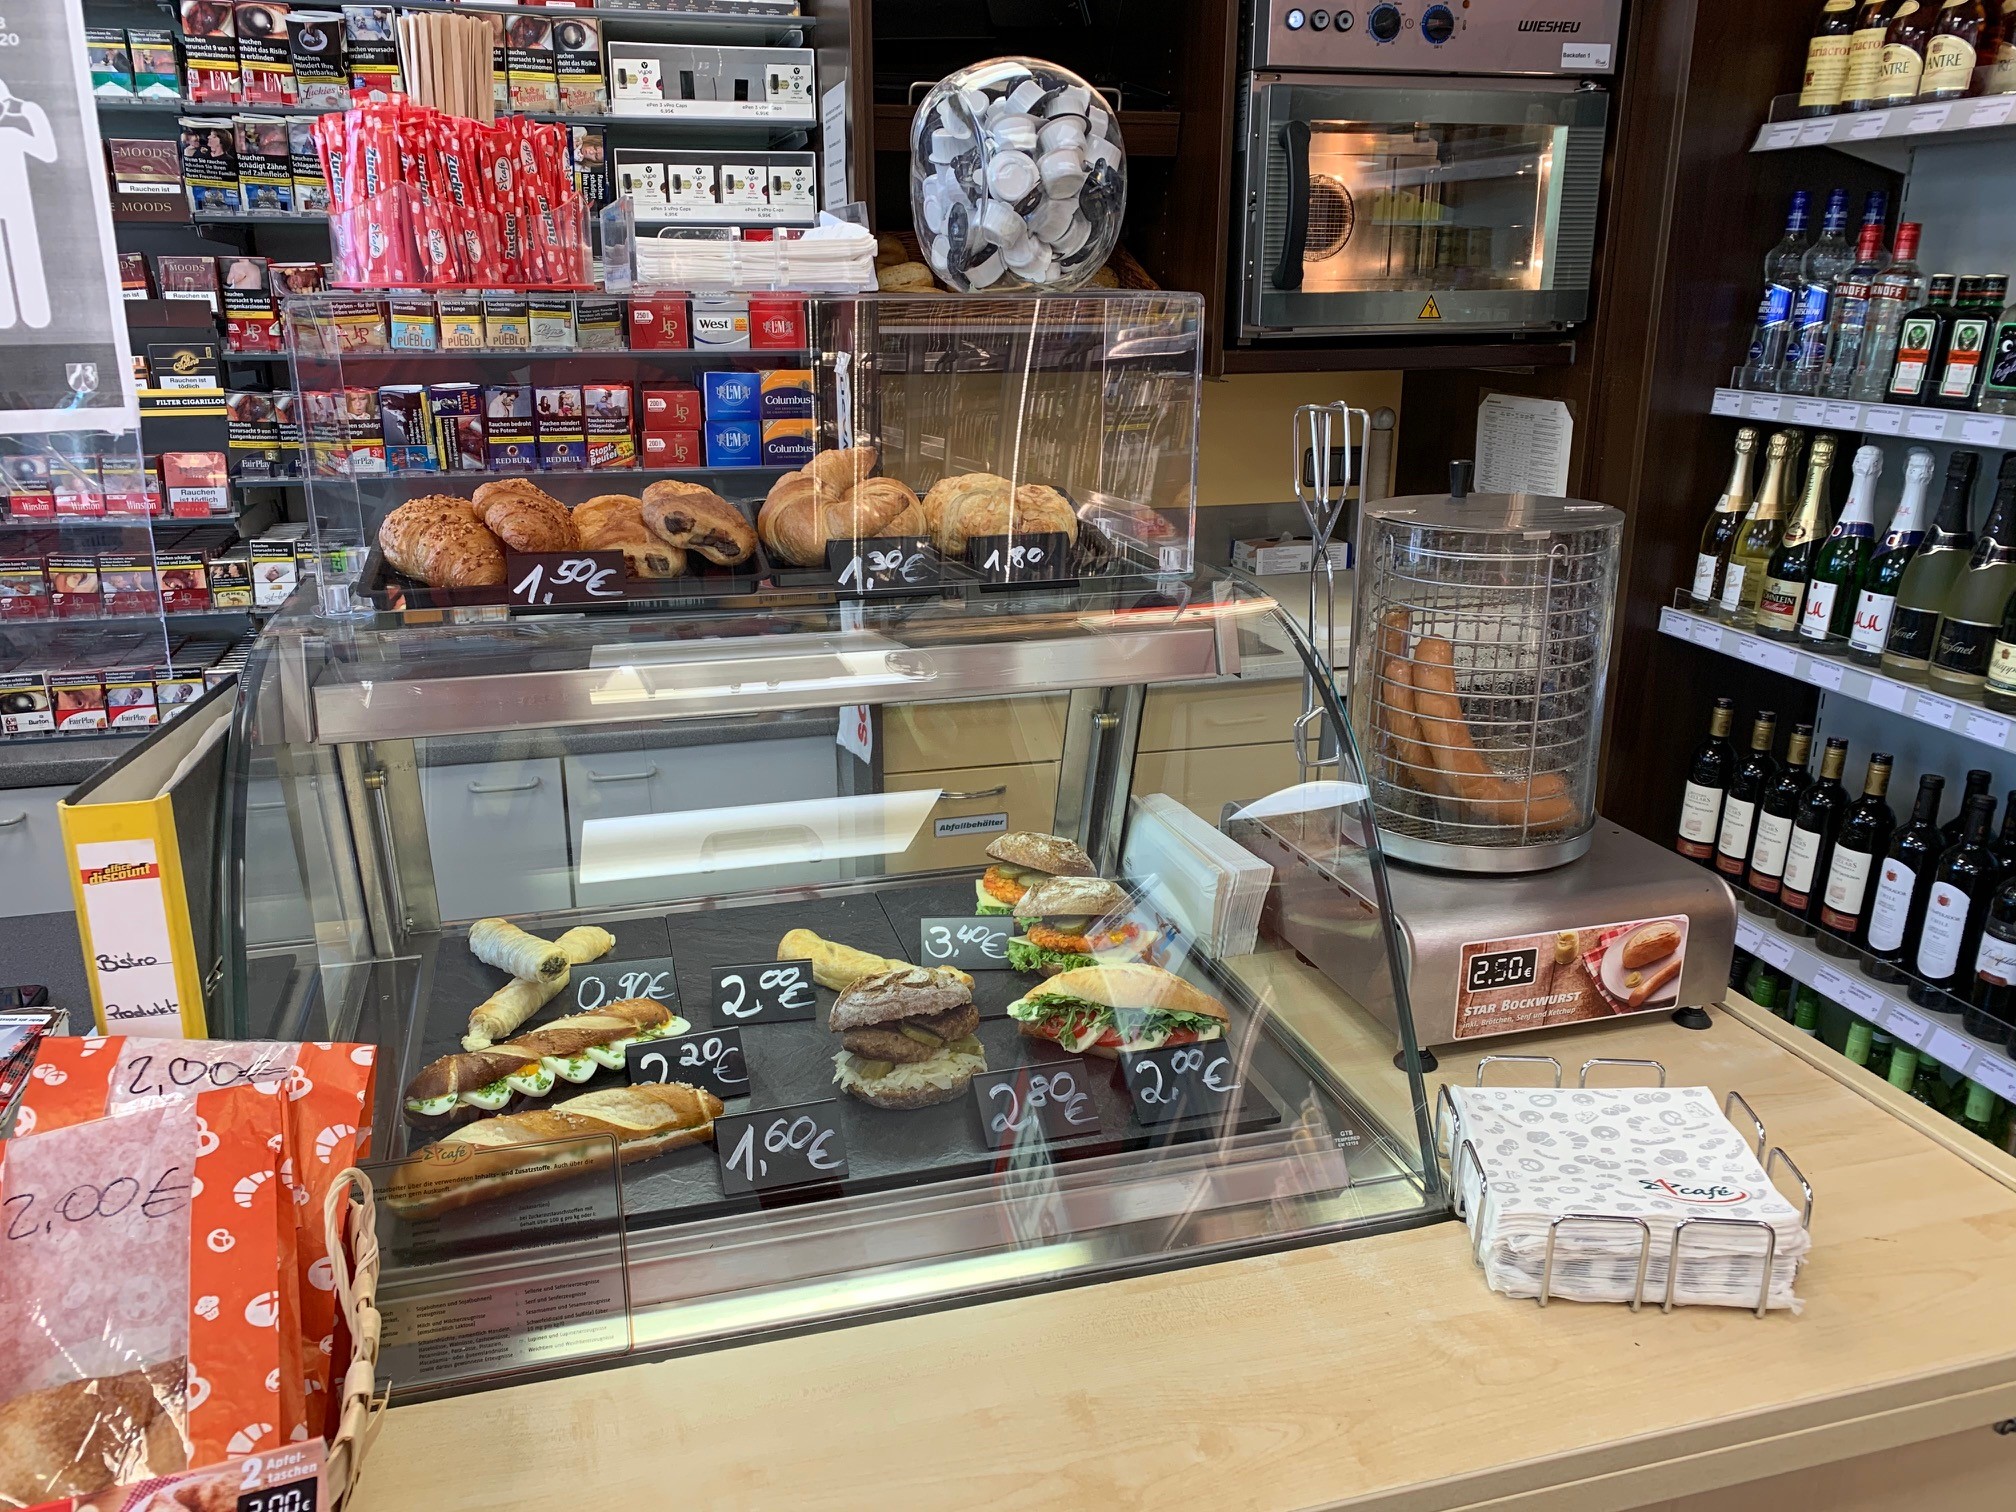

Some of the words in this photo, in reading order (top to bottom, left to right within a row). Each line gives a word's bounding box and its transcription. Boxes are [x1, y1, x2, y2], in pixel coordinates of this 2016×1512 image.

[1518, 20, 1581, 33] WIESHEU
[209, 70, 231, 91] L&M
[303, 86, 335, 99] Luckies
[120, 147, 171, 157] MOODS
[239, 162, 265, 170] schädigt
[249, 170, 290, 178] Zahnfleisch
[331, 152, 342, 202] Zucker
[447, 154, 464, 208] Zucker
[122, 202, 172, 212] MOODS
[538, 196, 558, 245] Zucker
[506, 212, 515, 259] Zucker
[699, 319, 728, 330] West
[398, 334, 431, 347] PUEBLO
[448, 333, 481, 347] PUEBLO
[493, 333, 525, 346] PUEBLO
[765, 395, 811, 405] Columbus
[589, 443, 614, 457] Stopf-
[768, 443, 814, 453] Columbus
[590, 451, 617, 466] Beutel
[22, 501, 49, 511] Winston
[71, 501, 100, 511] Winston
[127, 500, 156, 510] Winston
[69, 717, 95, 727] FairPlay
[121, 714, 146, 723] FairPlay
[939, 818, 1004, 832] Abfallbehälter
[89, 864, 150, 885] discount
[105, 863, 132, 874] office
[926, 926, 1008, 960] 3,40€
[95, 953, 158, 973] Bistro
[721, 967, 816, 1018] 2,00€
[1464, 1004, 1495, 1017] STAR
[1501, 991, 1582, 1011] BOCKWURST
[1462, 1019, 1478, 1028] inkl.
[1481, 1015, 1514, 1026] Brötchen,
[1516, 1013, 1531, 1021] Senf
[1534, 1011, 1547, 1019] und
[1548, 1006, 1576, 1018] Ketchup
[1137, 1048, 1242, 1106] 2,00€
[1334, 1135, 1361, 1144] TEMPERED
[724, 1115, 844, 1182] 1,60€
[434, 1176, 473, 1186] verwendeten
[475, 1172, 500, 1180] Inhalts-
[515, 1165, 552, 1175] Zusatzstoffe.
[409, 1191, 421, 1199] gern
[423, 1187, 451, 1196] Auskunft.
[3, 1167, 188, 1241] 2,00€
[417, 1309, 446, 1318] erzeugnisse
[240, 1457, 263, 1491] 2
[266, 1452, 306, 1470] Apfel-
[268, 1463, 318, 1483] taschen
